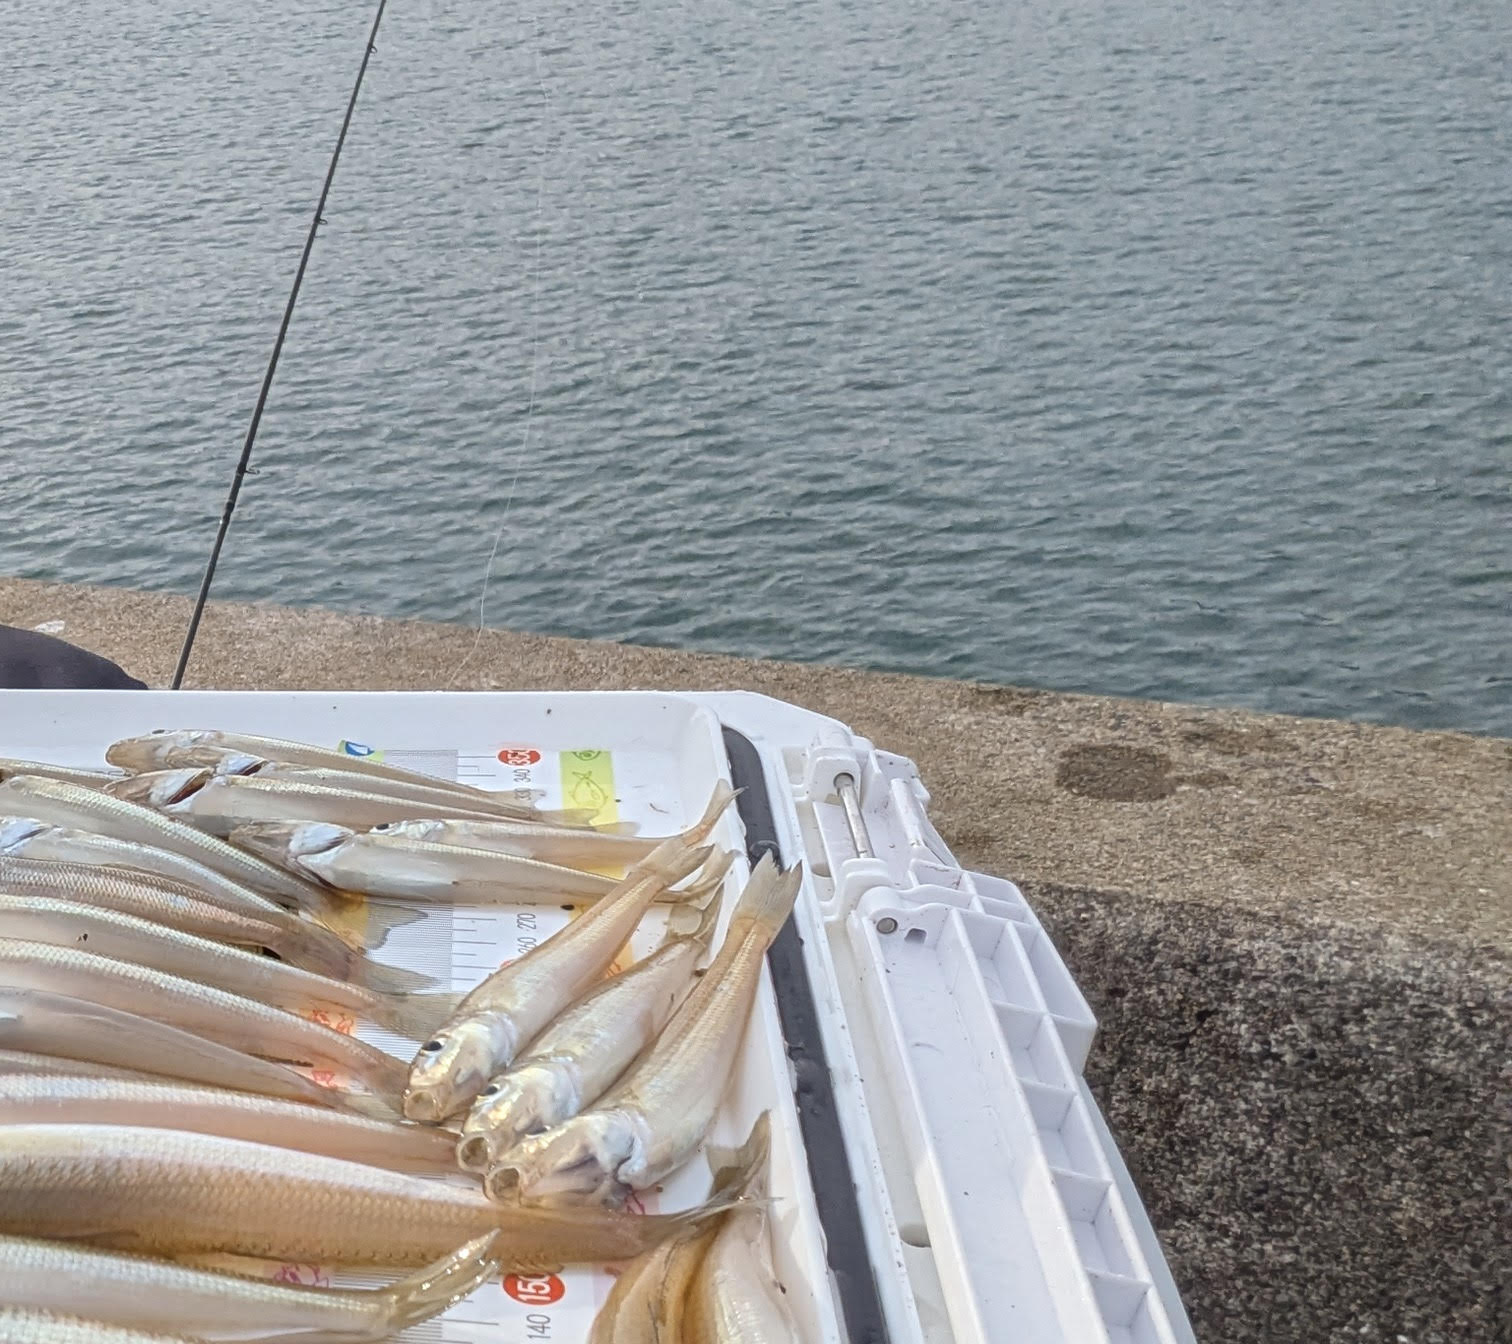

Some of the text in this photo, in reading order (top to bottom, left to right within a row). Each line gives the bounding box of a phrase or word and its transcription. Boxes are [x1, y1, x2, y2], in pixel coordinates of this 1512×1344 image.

[513, 769, 531, 783] 340
[516, 913, 536, 930] 270
[526, 1314, 551, 1339] 140
